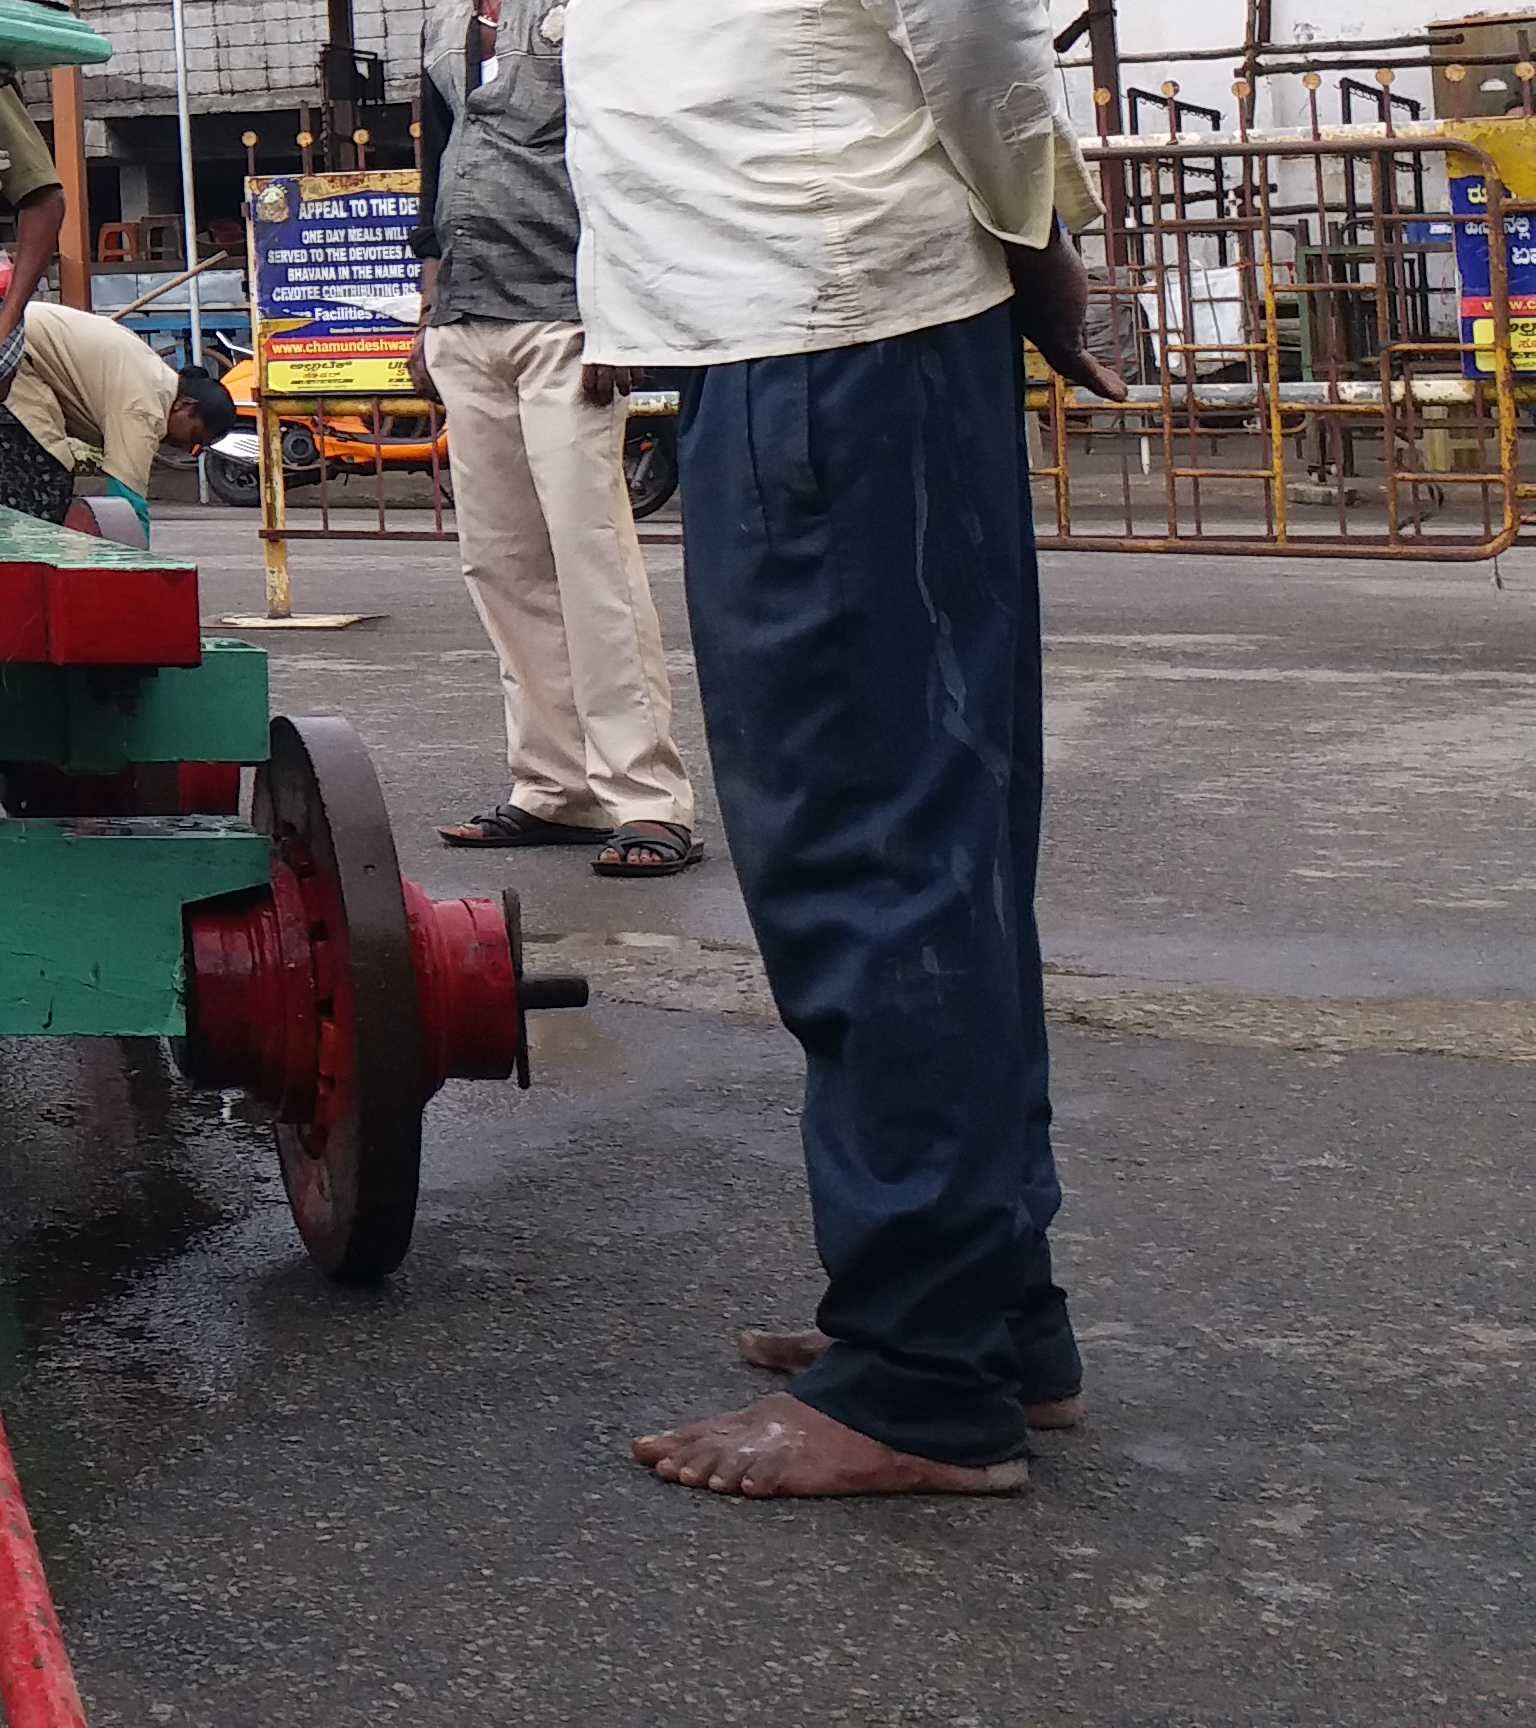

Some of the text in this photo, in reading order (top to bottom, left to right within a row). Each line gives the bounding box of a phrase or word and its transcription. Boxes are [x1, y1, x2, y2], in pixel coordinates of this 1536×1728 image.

[298, 200, 347, 220] APPEAL
[349, 199, 368, 217] TO
[369, 197, 397, 216] THE
[301, 229, 323, 244] ONE
[325, 228, 346, 243] DAY
[347, 226, 383, 242] MEALS
[267, 249, 308, 264] SERVED
[309, 248, 325, 262] TO
[326, 247, 348, 261] THE
[349, 245, 403, 261] DEVOTEES
[287, 263, 422, 282] BHAVANA IN THE NAME OF
[272, 338, 415, 354] www.chamundeshwari
